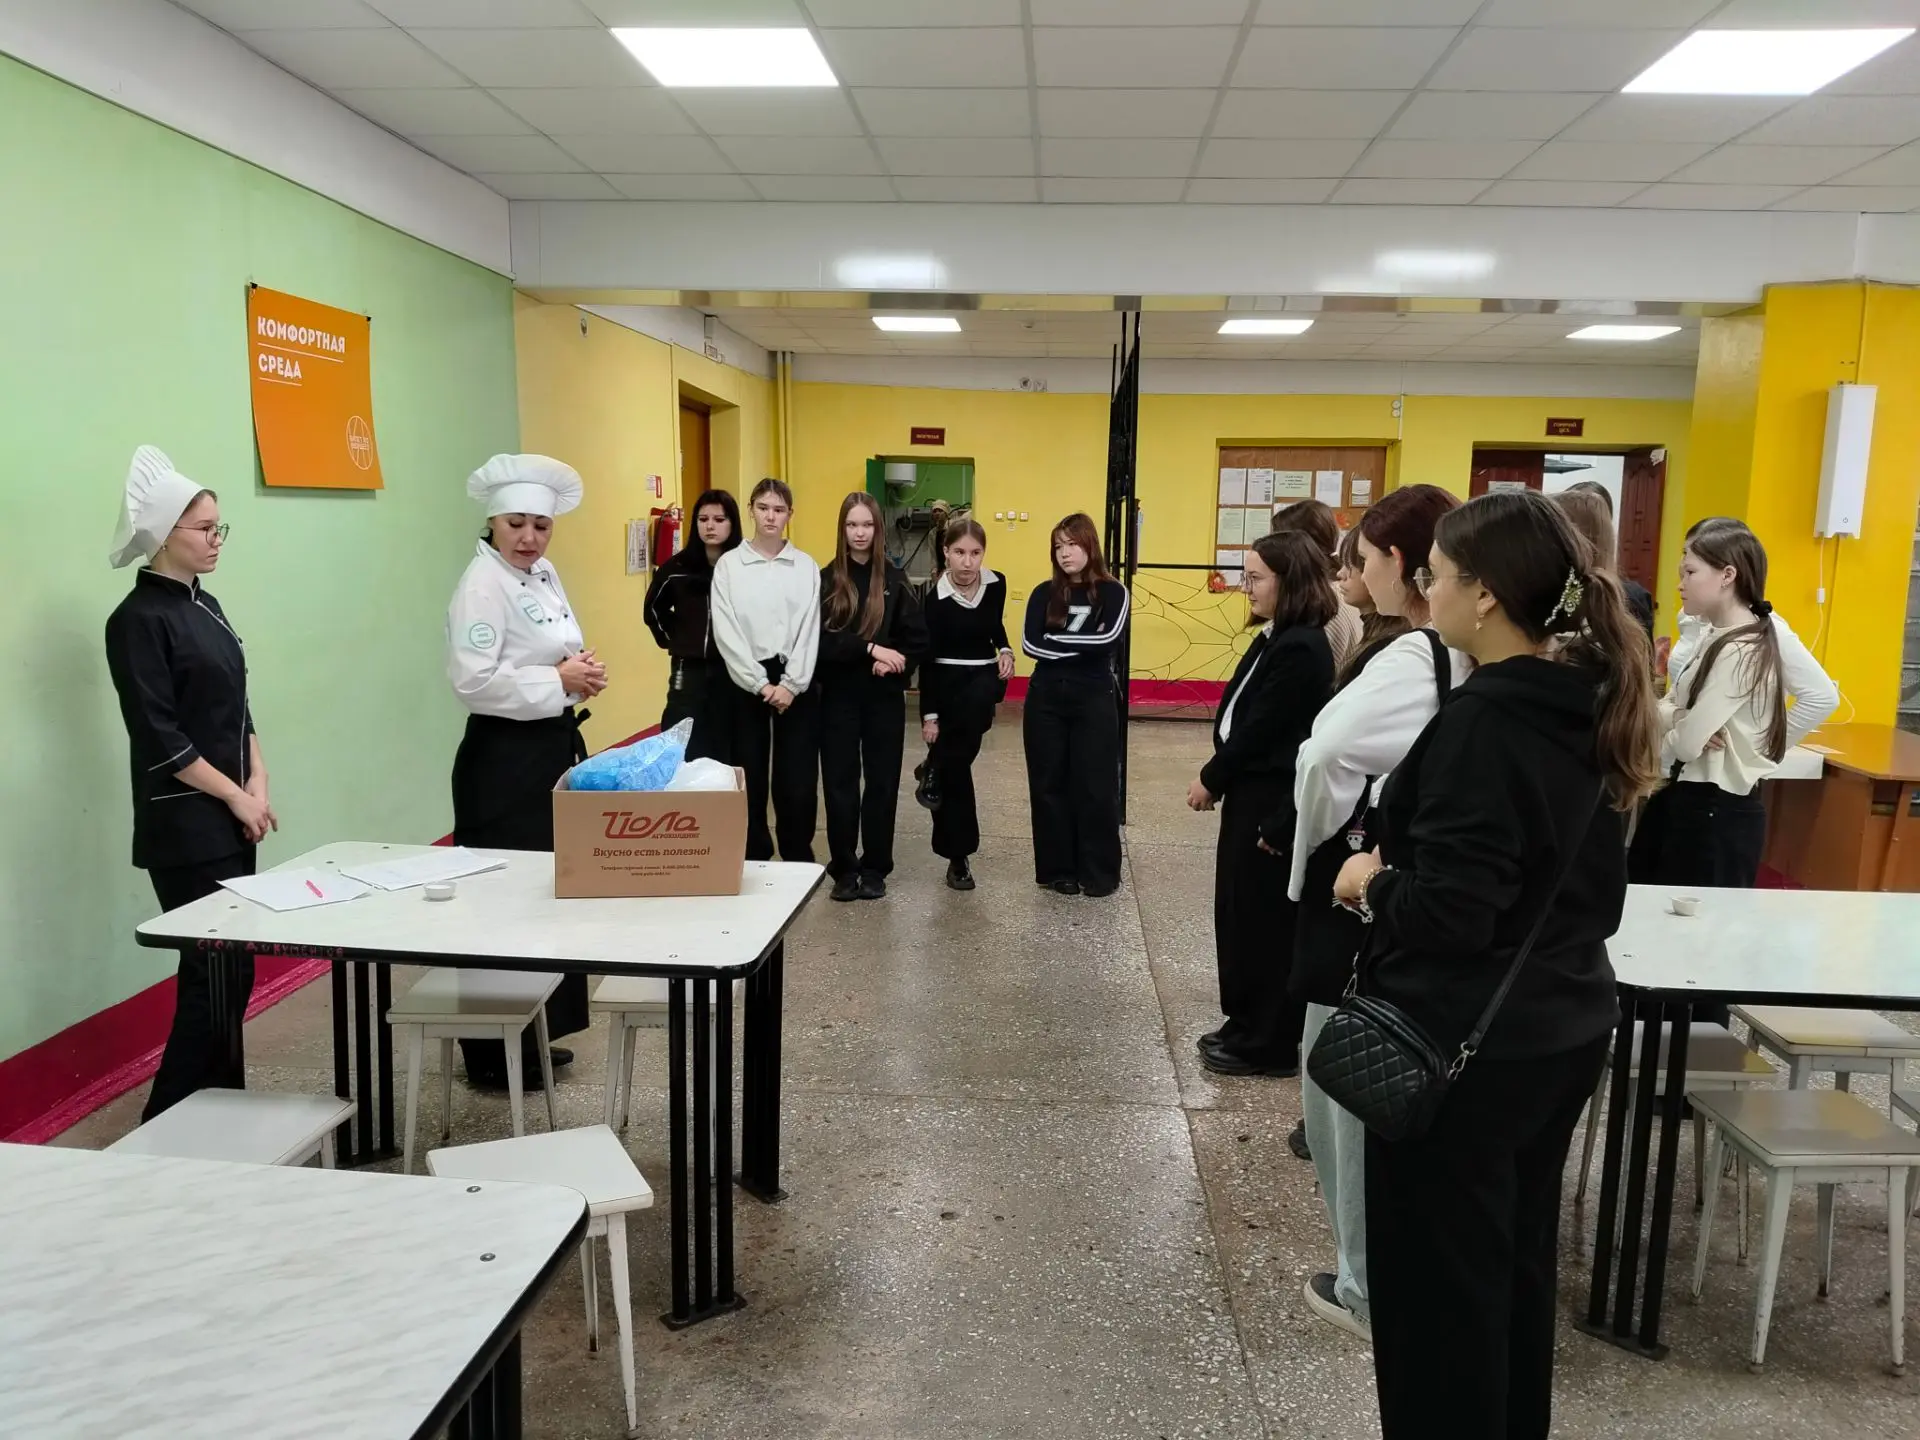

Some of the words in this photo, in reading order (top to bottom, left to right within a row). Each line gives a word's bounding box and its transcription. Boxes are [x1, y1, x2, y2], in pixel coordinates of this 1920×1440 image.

[257, 316, 345, 354] КОМФОРТНАЯ
[258, 353, 302, 379] СРЕДА
[1067, 605, 1092, 632] 7
[593, 847, 632, 858] Вкусно
[634, 848, 661, 857] есть
[662, 846, 711, 856] полезно!
